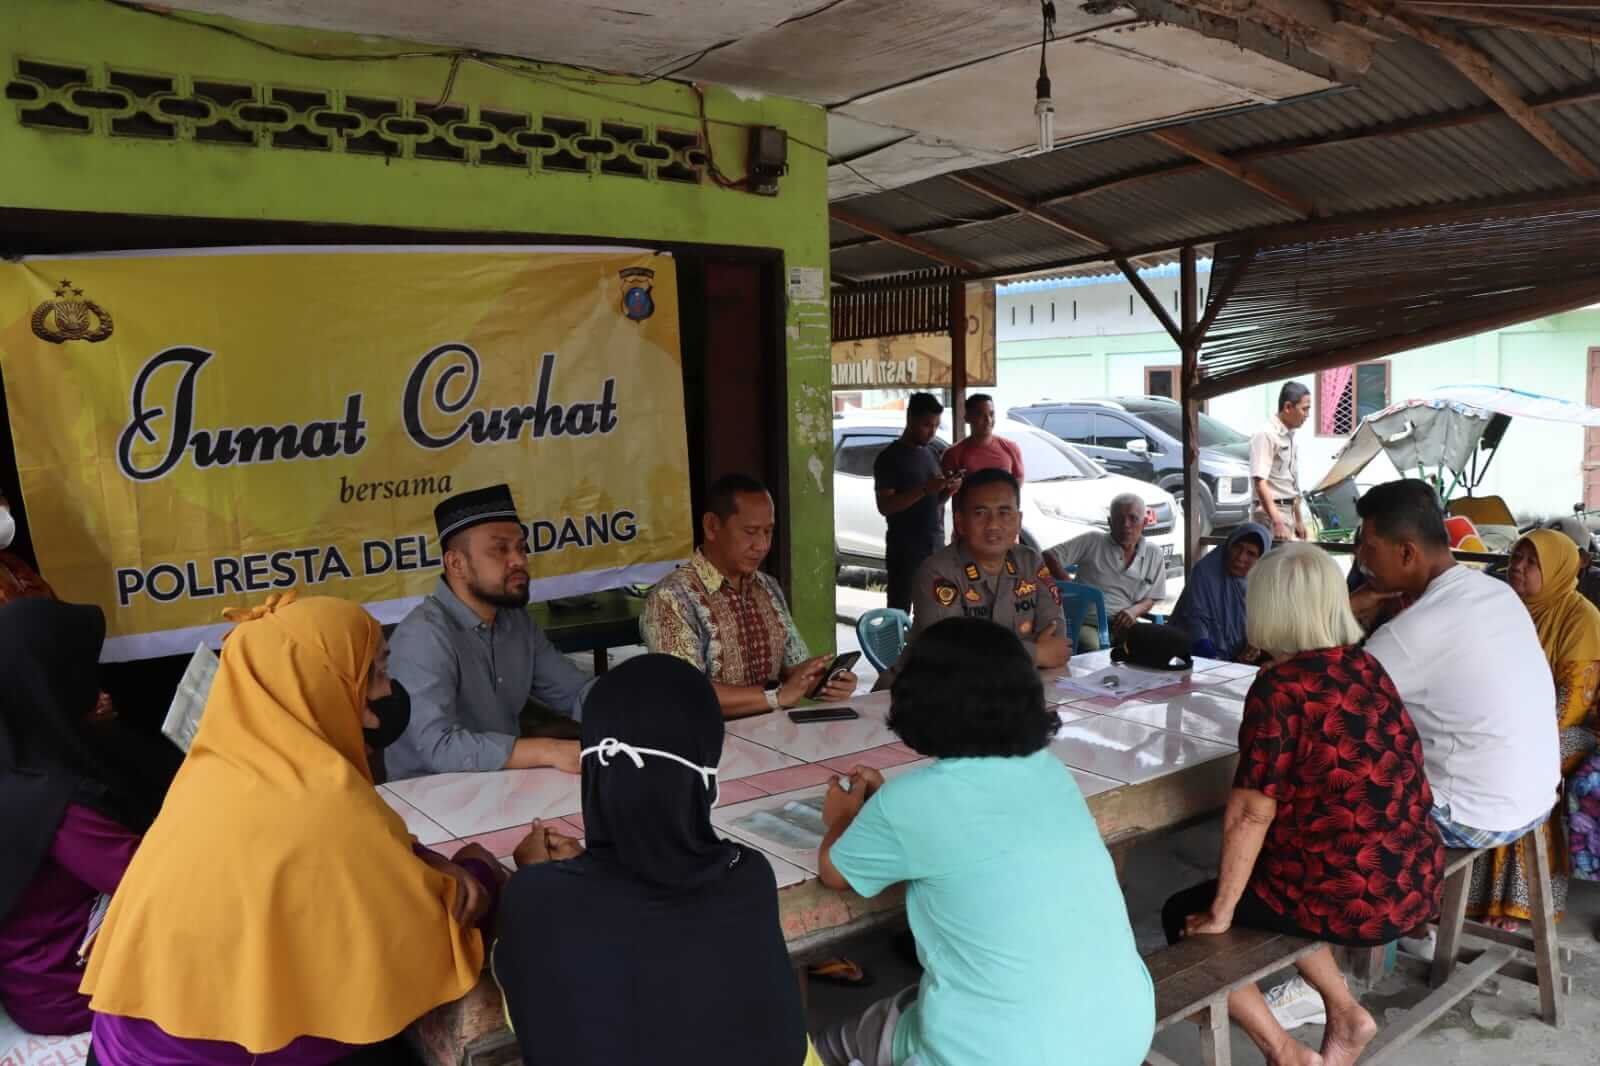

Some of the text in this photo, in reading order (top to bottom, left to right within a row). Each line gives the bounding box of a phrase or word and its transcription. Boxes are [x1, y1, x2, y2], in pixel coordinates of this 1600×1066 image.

[118, 344, 617, 480] Jumat Curhat
[339, 473, 453, 503] bersama
[117, 510, 637, 604] POLRESTA DEL RDANG
